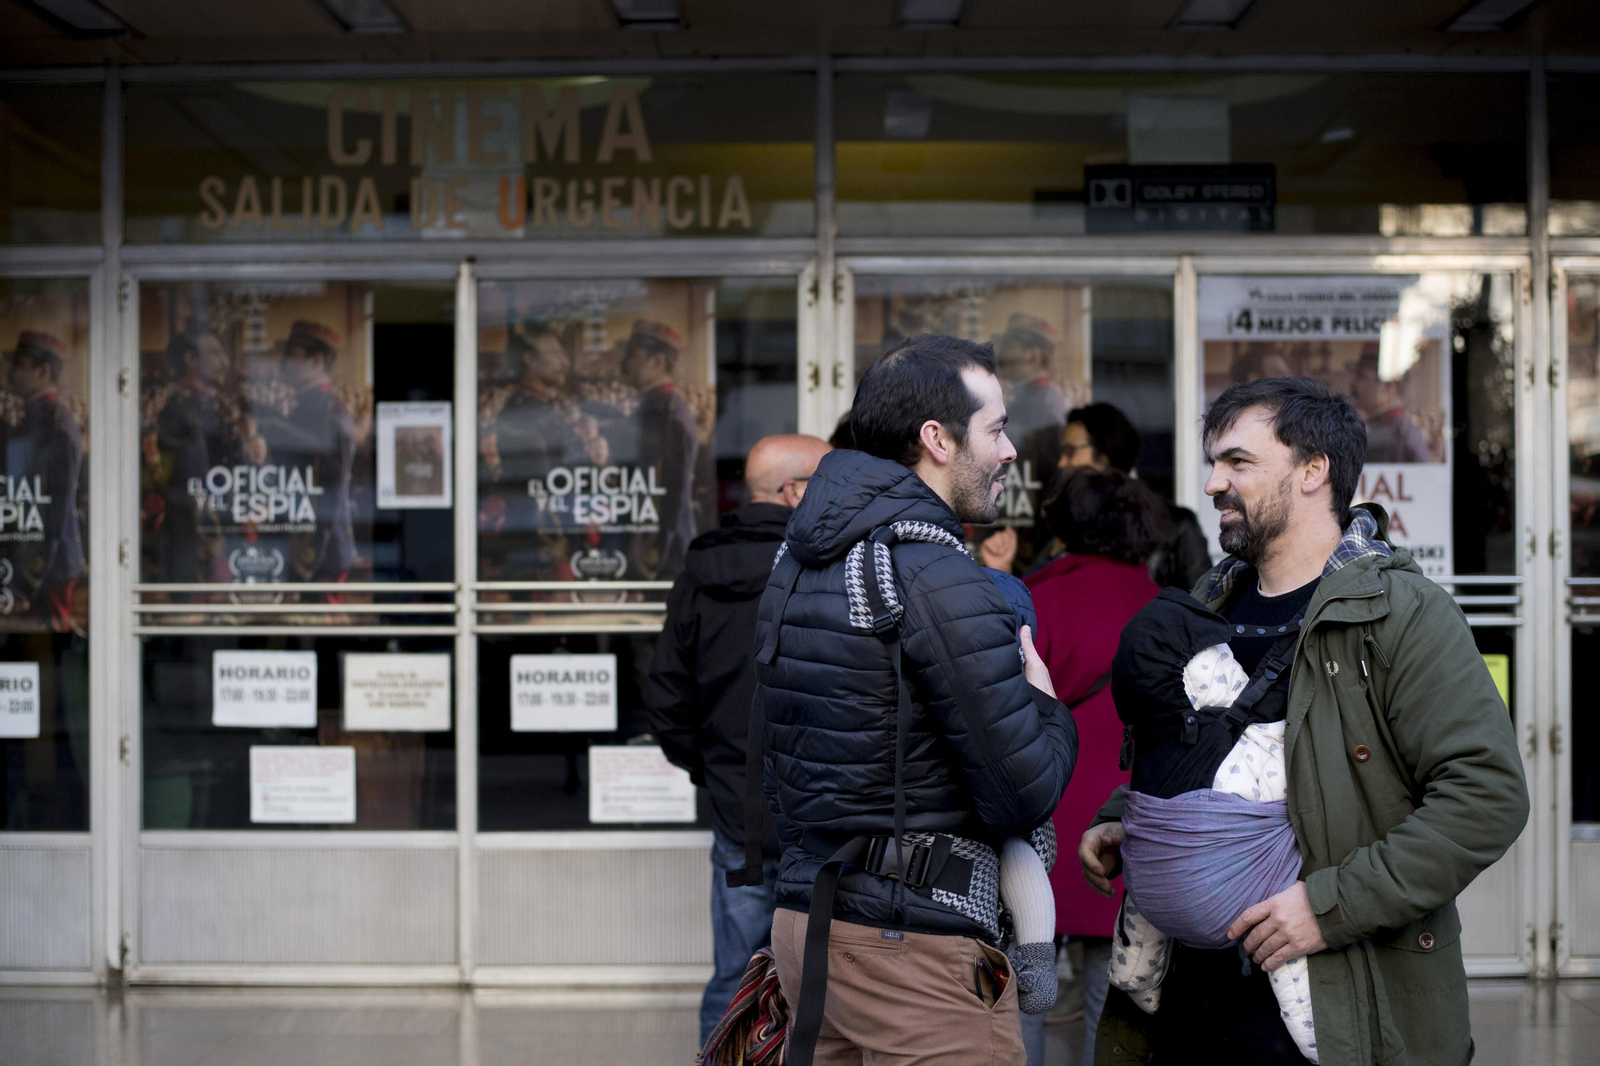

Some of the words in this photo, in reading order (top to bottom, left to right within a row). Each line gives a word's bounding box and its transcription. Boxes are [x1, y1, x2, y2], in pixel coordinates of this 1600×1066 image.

[327, 83, 653, 166] CINEMA
[198, 175, 384, 231] SALIDA
[409, 176, 470, 230] DE
[498, 175, 753, 230] URGENCIA
[1201, 184, 1265, 200] STEREO
[1258, 316, 1324, 334] MEJOR
[1331, 316, 1386, 334] PELIC
[205, 464, 325, 496] OFICIAL
[546, 465, 668, 496] OFICIAL
[1005, 460, 1043, 490] AL
[1360, 472, 1413, 503] IAL
[0, 676, 33, 693] RIO
[219, 664, 311, 682] HORARIO
[517, 669, 611, 686] HORARIO
